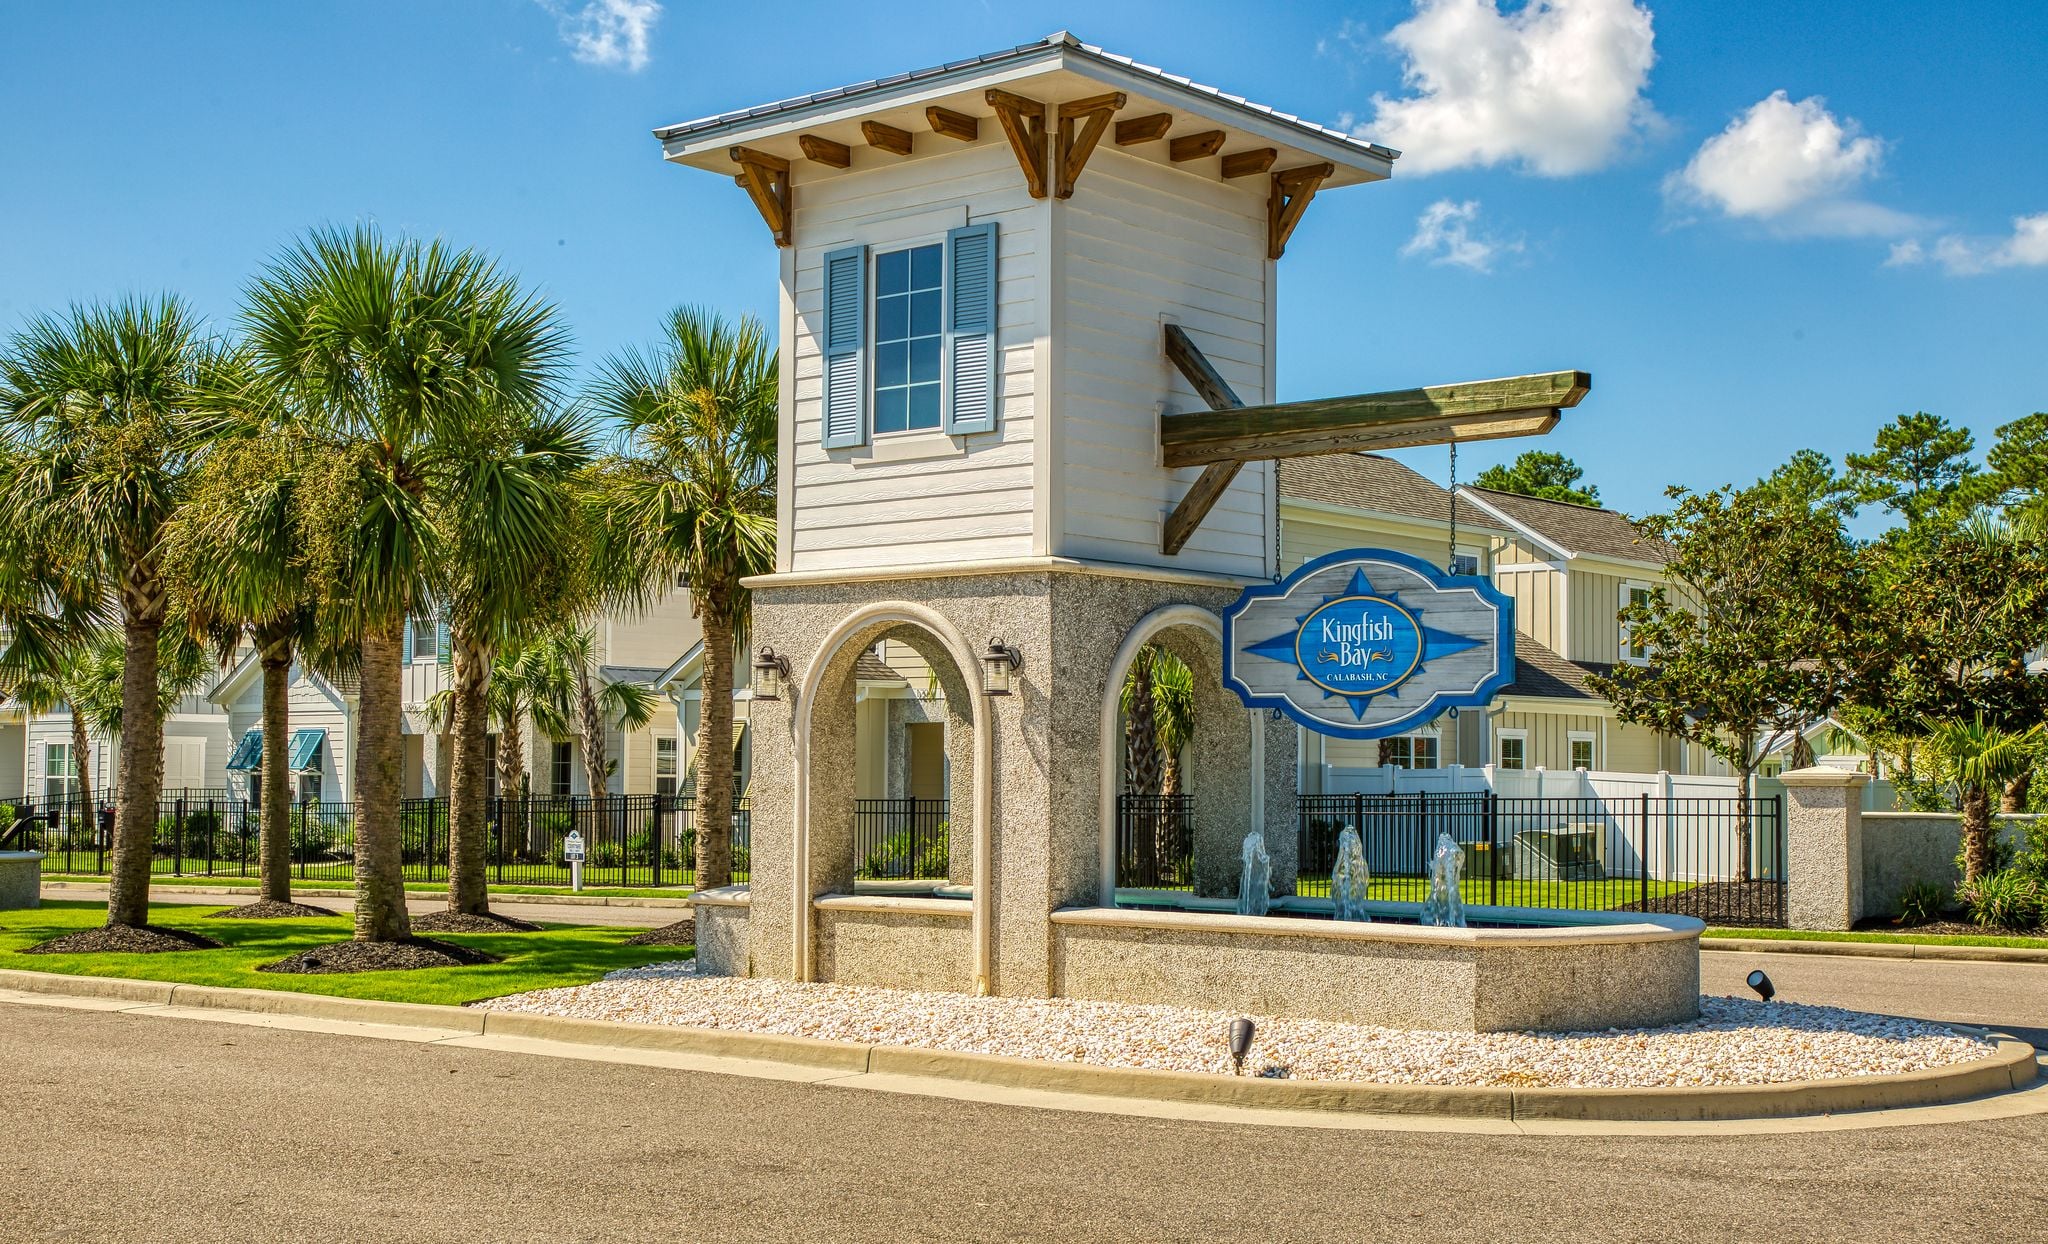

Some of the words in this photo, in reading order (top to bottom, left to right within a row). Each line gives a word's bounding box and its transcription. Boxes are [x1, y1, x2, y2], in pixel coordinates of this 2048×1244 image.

[1322, 611, 1393, 646] Kingfish
[1340, 642, 1371, 670] Bay
[1326, 673, 1375, 682] CALABASH,
[1376, 673, 1389, 681] NC
